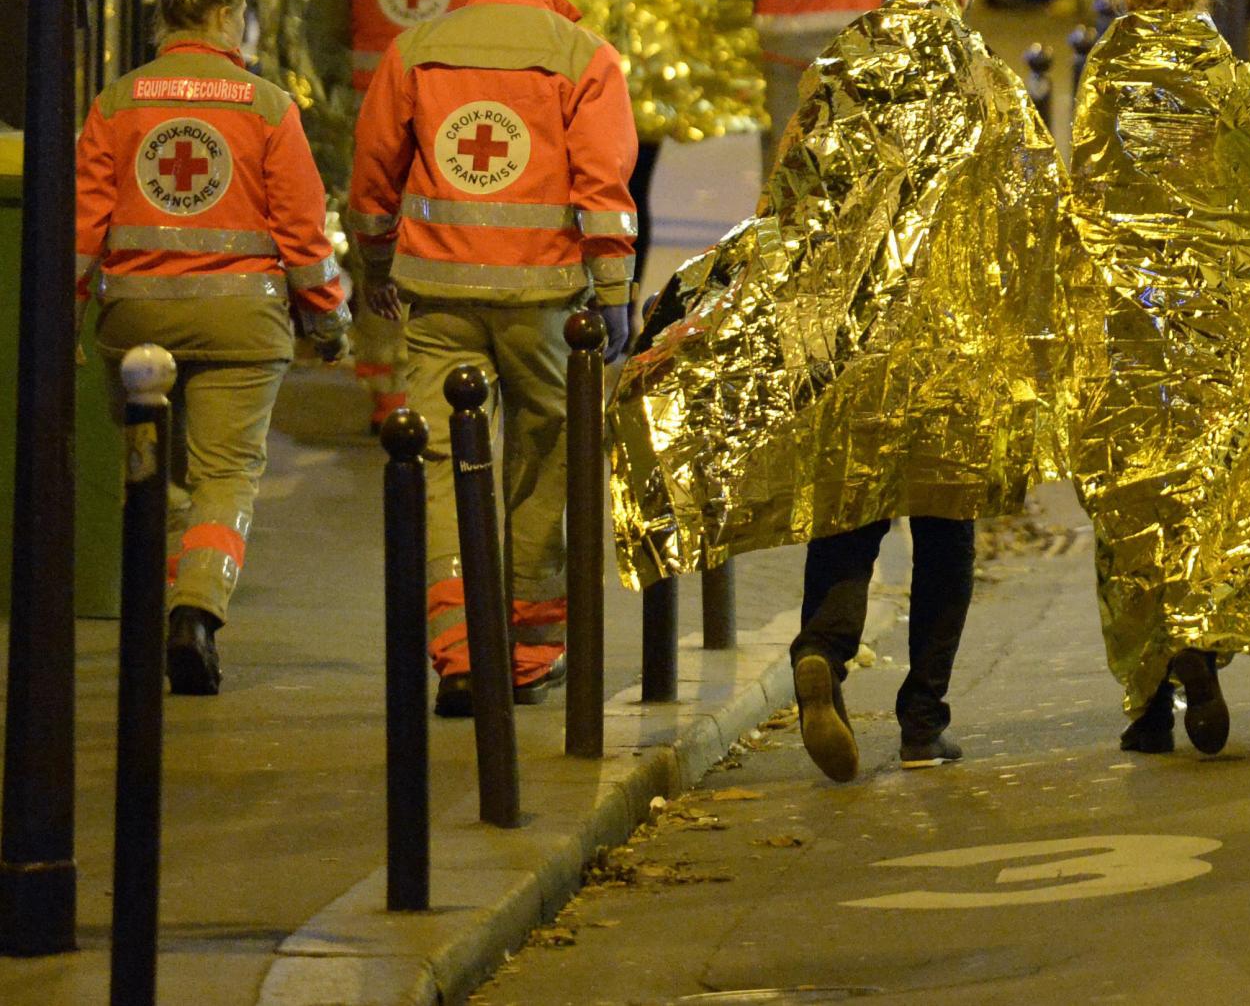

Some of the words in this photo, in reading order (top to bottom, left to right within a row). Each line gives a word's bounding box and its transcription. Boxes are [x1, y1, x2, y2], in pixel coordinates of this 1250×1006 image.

[137, 80, 184, 99] EQUIPIER
[186, 79, 252, 101] SECOURISTE
[446, 110, 521, 141] CROIX-ROUGE
[145, 126, 222, 161] CROIX-ROUGE
[446, 157, 519, 187] FRANÇAISE
[146, 178, 220, 208] FRANÇAISE
